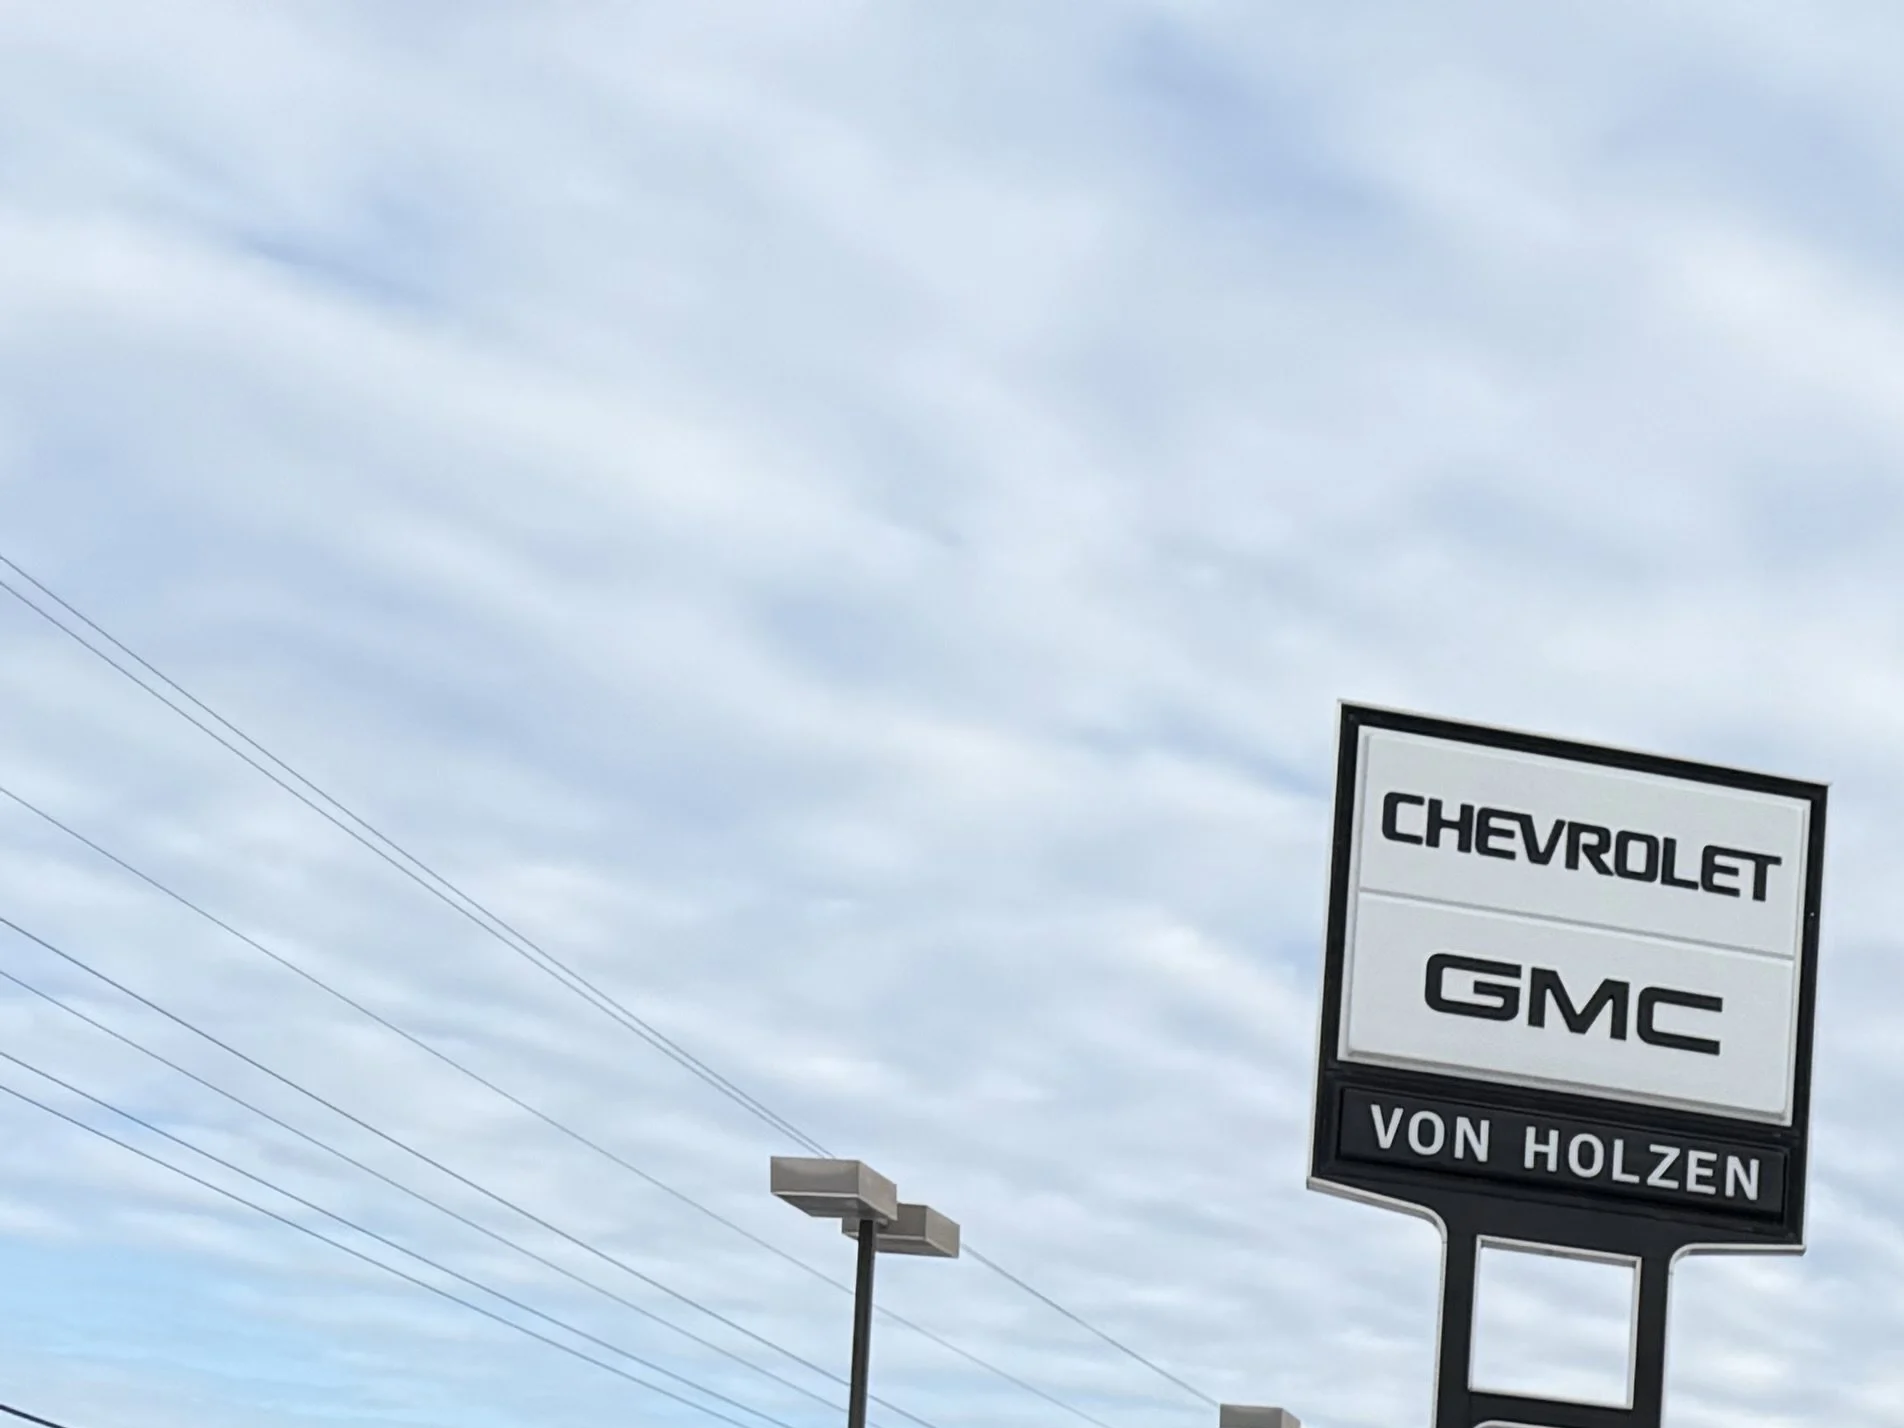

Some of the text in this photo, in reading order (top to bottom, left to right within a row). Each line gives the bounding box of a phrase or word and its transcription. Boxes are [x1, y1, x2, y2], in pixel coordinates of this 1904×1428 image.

[1381, 791, 1782, 903] CHEVROLET
[1424, 953, 1723, 1056] GMC
[1370, 1104, 1760, 1202] VON HOLZEN
